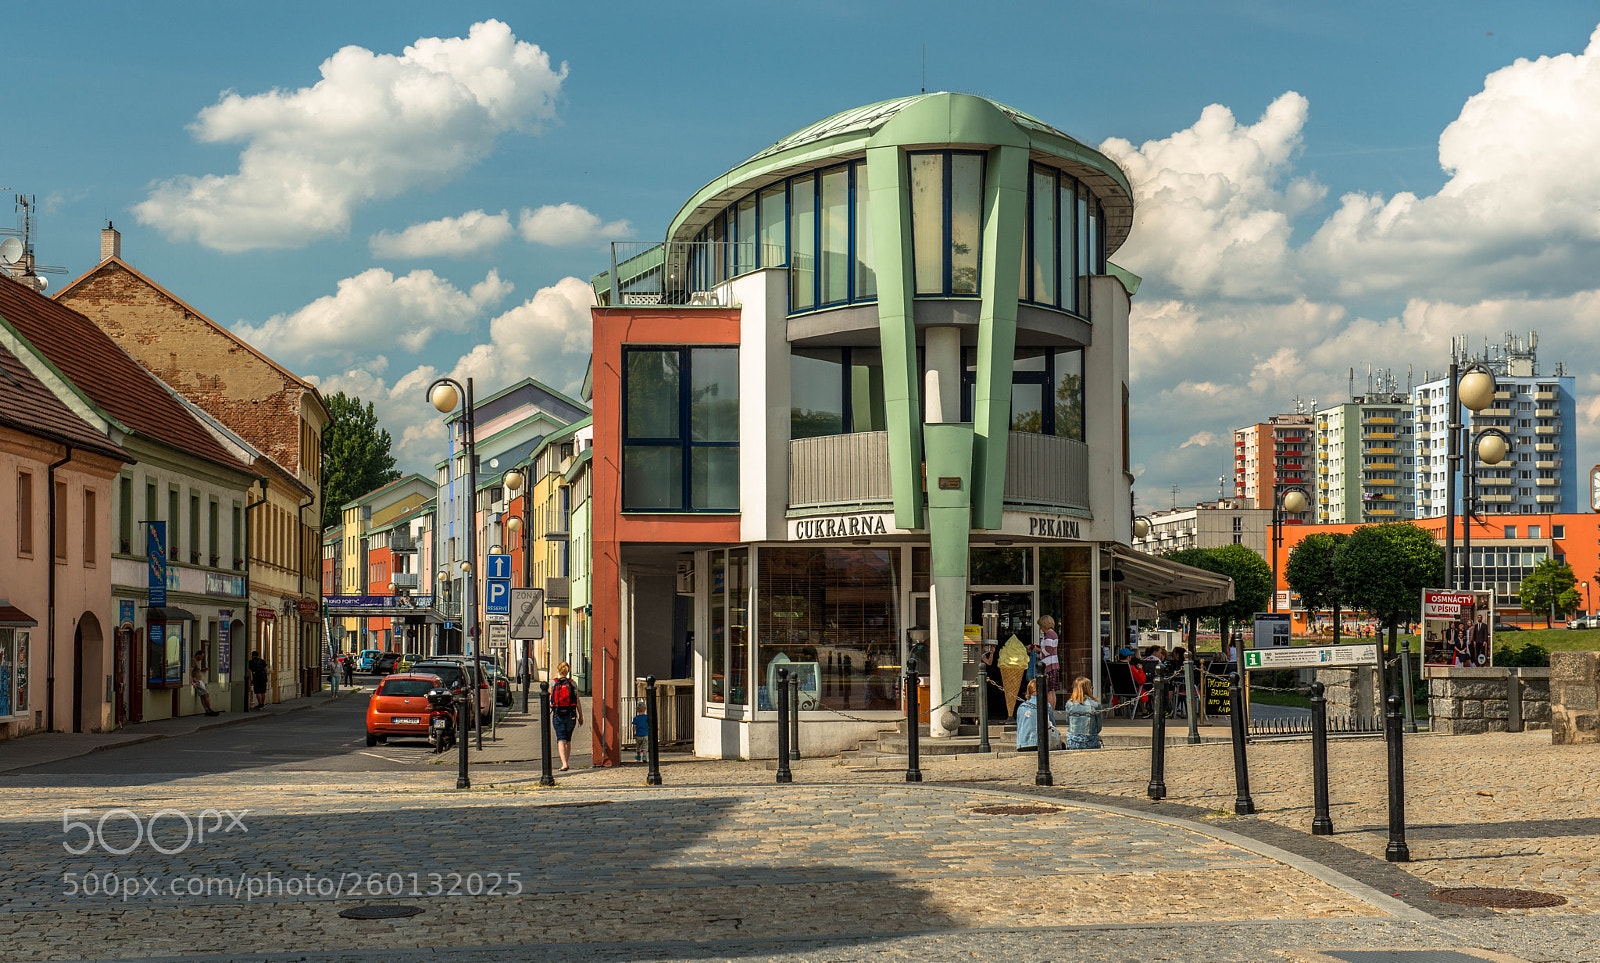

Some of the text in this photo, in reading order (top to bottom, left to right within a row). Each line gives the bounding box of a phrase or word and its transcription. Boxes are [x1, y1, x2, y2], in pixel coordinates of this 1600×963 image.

[796, 513, 887, 539] CUKRÁRNA
[1029, 514, 1080, 538] PEKÁRNA
[491, 584, 505, 603] P
[1431, 595, 1472, 604] OSMNÁCTÝ
[1437, 604, 1459, 613] PÍSKU
